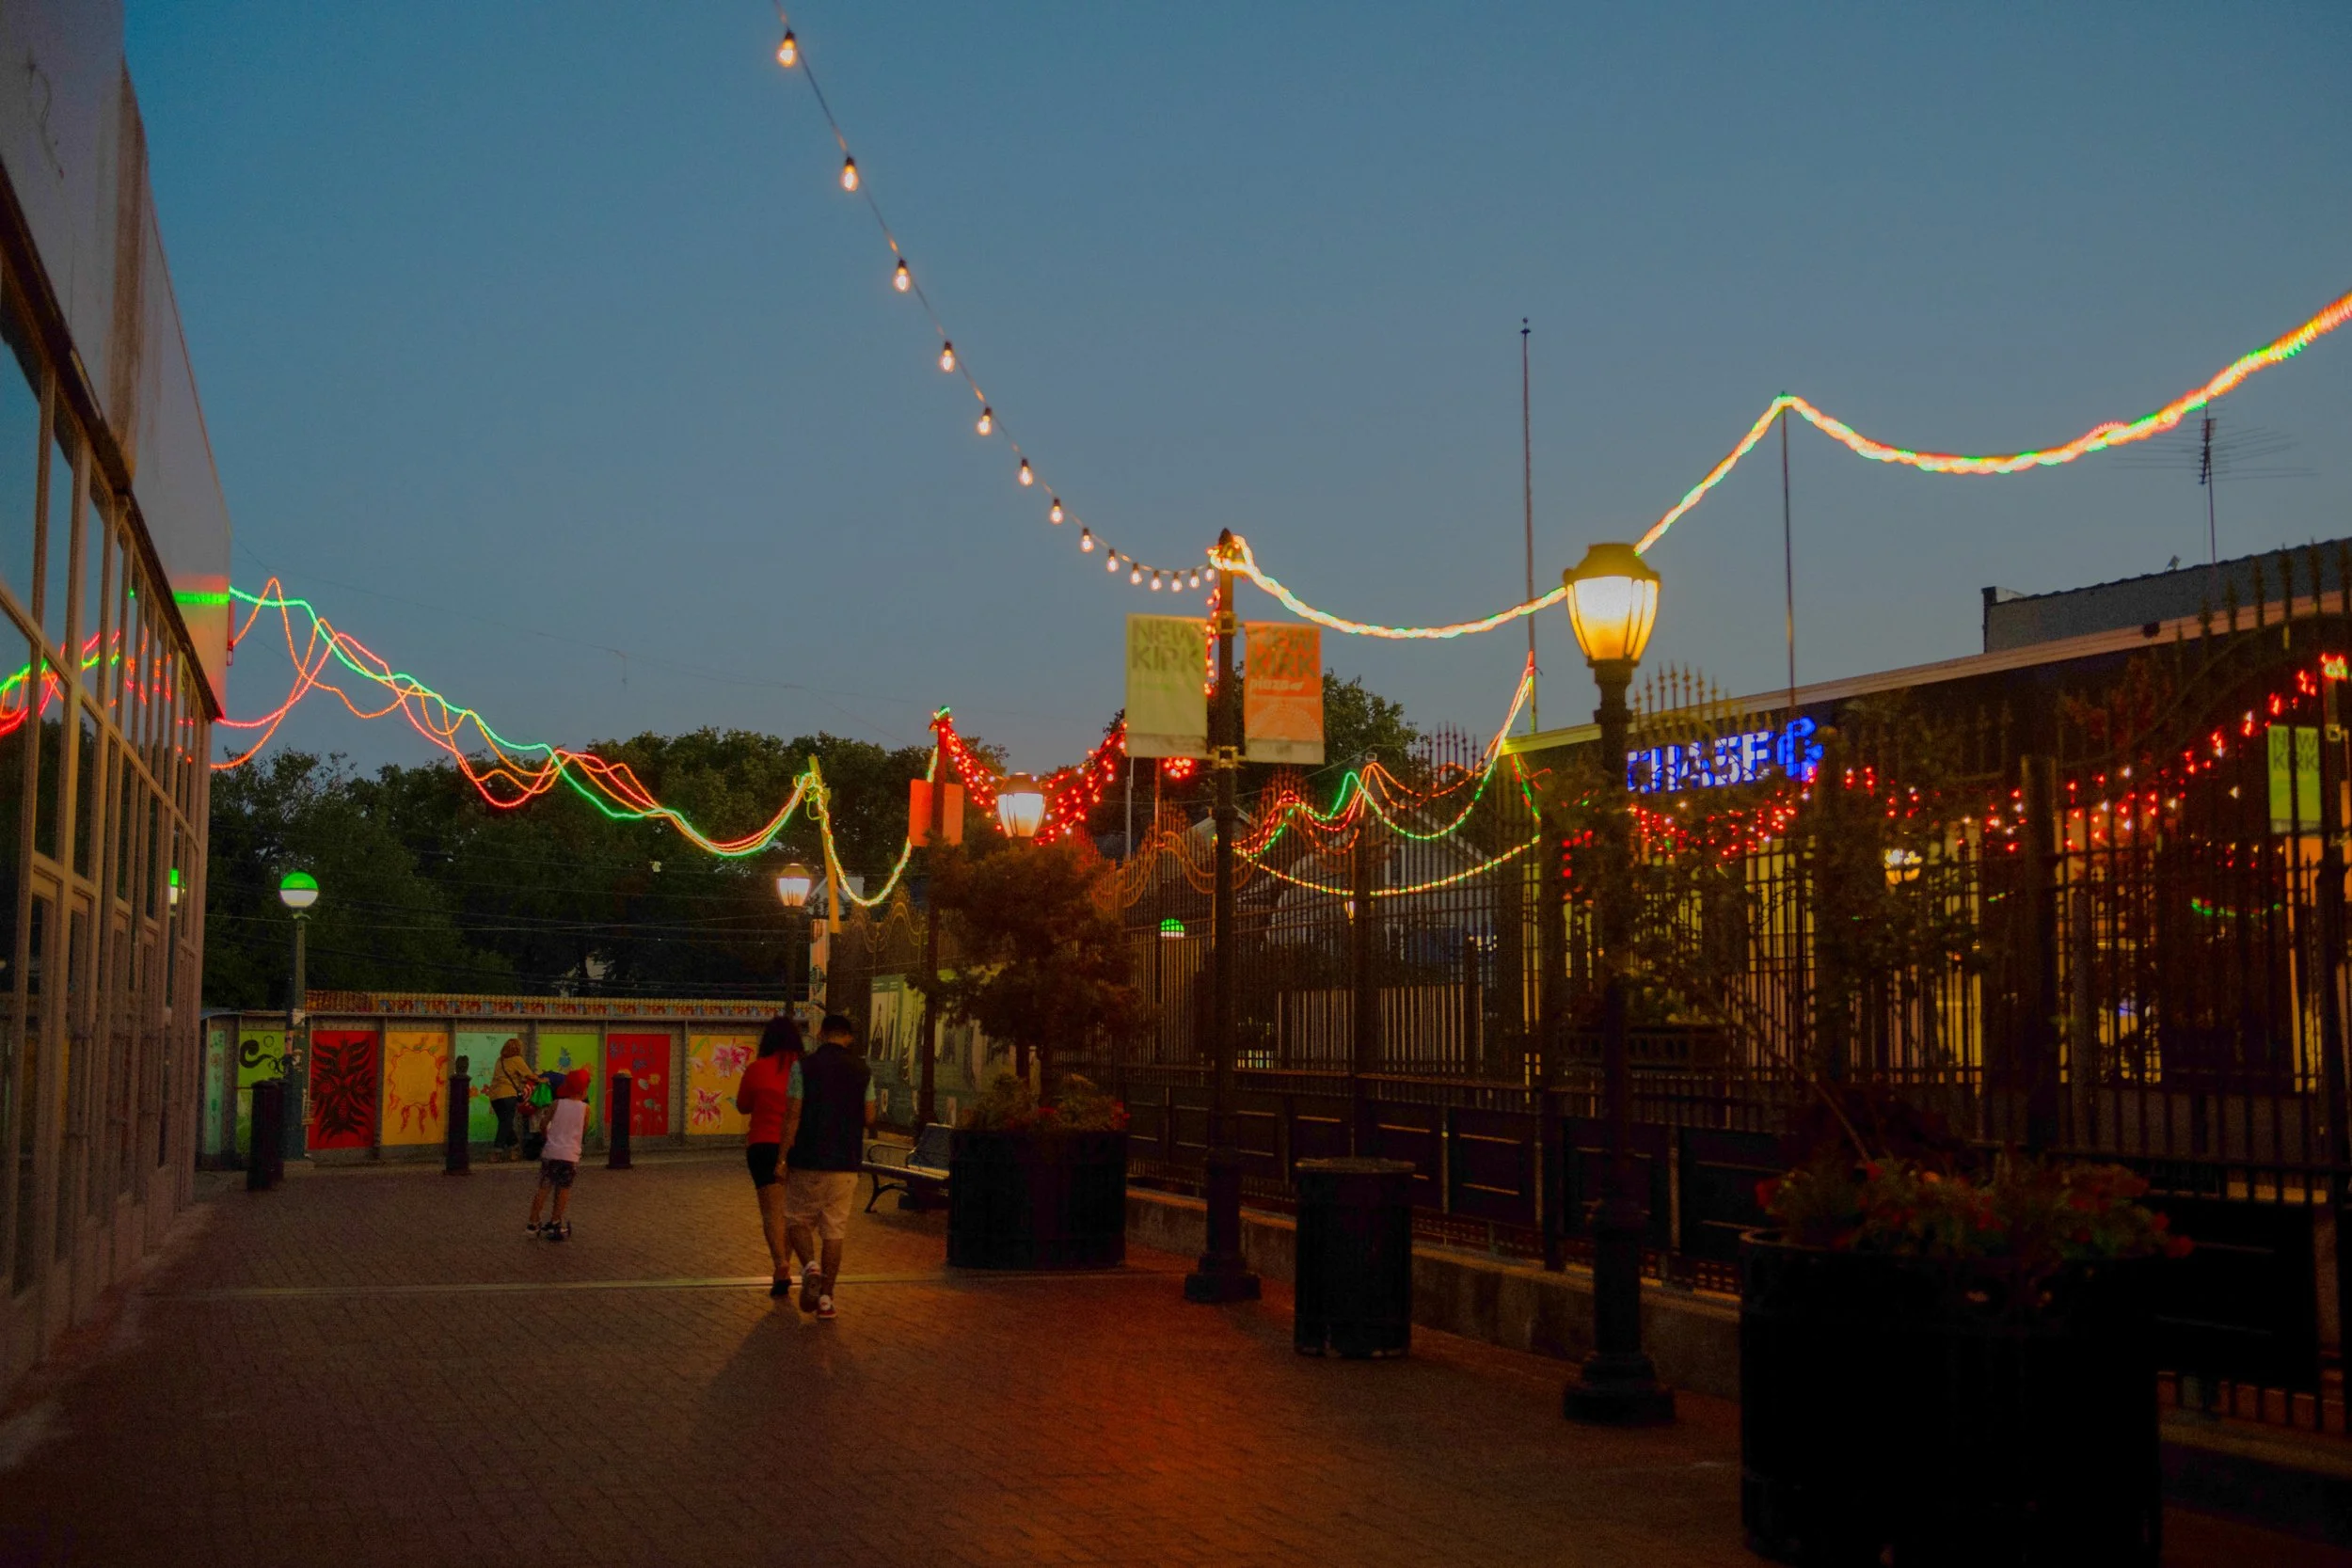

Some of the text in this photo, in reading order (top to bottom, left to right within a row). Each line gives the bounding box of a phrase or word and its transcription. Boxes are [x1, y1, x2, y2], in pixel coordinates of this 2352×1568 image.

[1132, 619, 1204, 647] NEW
[1132, 644, 1201, 673] KIRK
[1249, 651, 1316, 677] KIRK
[1248, 675, 1290, 690] plaza
[2272, 730, 2319, 751] NW
[2272, 752, 2319, 771] KRK
